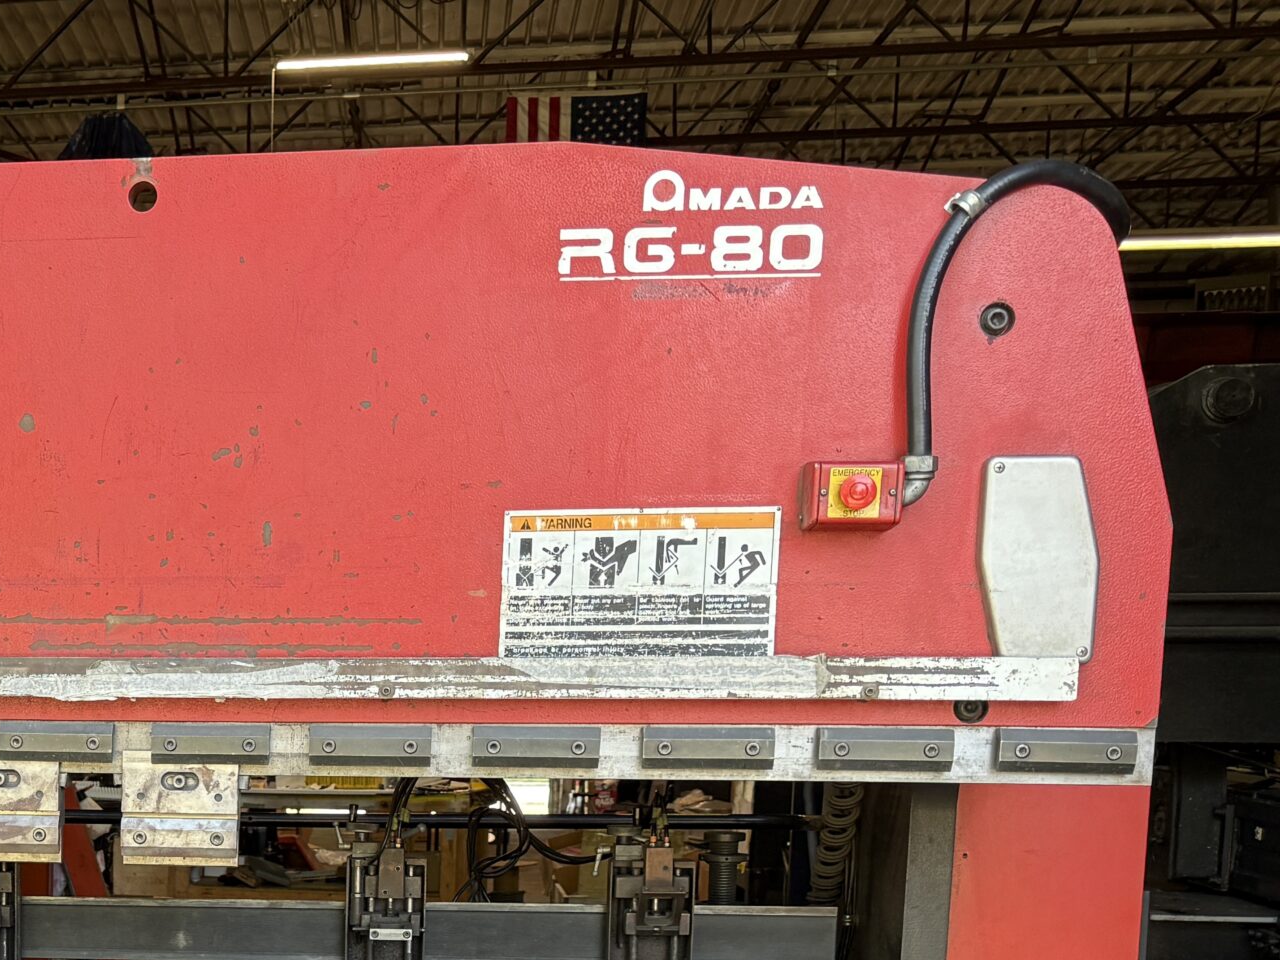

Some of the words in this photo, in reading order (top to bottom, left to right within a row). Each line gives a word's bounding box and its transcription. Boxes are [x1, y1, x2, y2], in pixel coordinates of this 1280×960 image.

[642, 169, 824, 212] AMADA
[558, 224, 824, 274] RG-80
[832, 468, 880, 477] EMERGENCY
